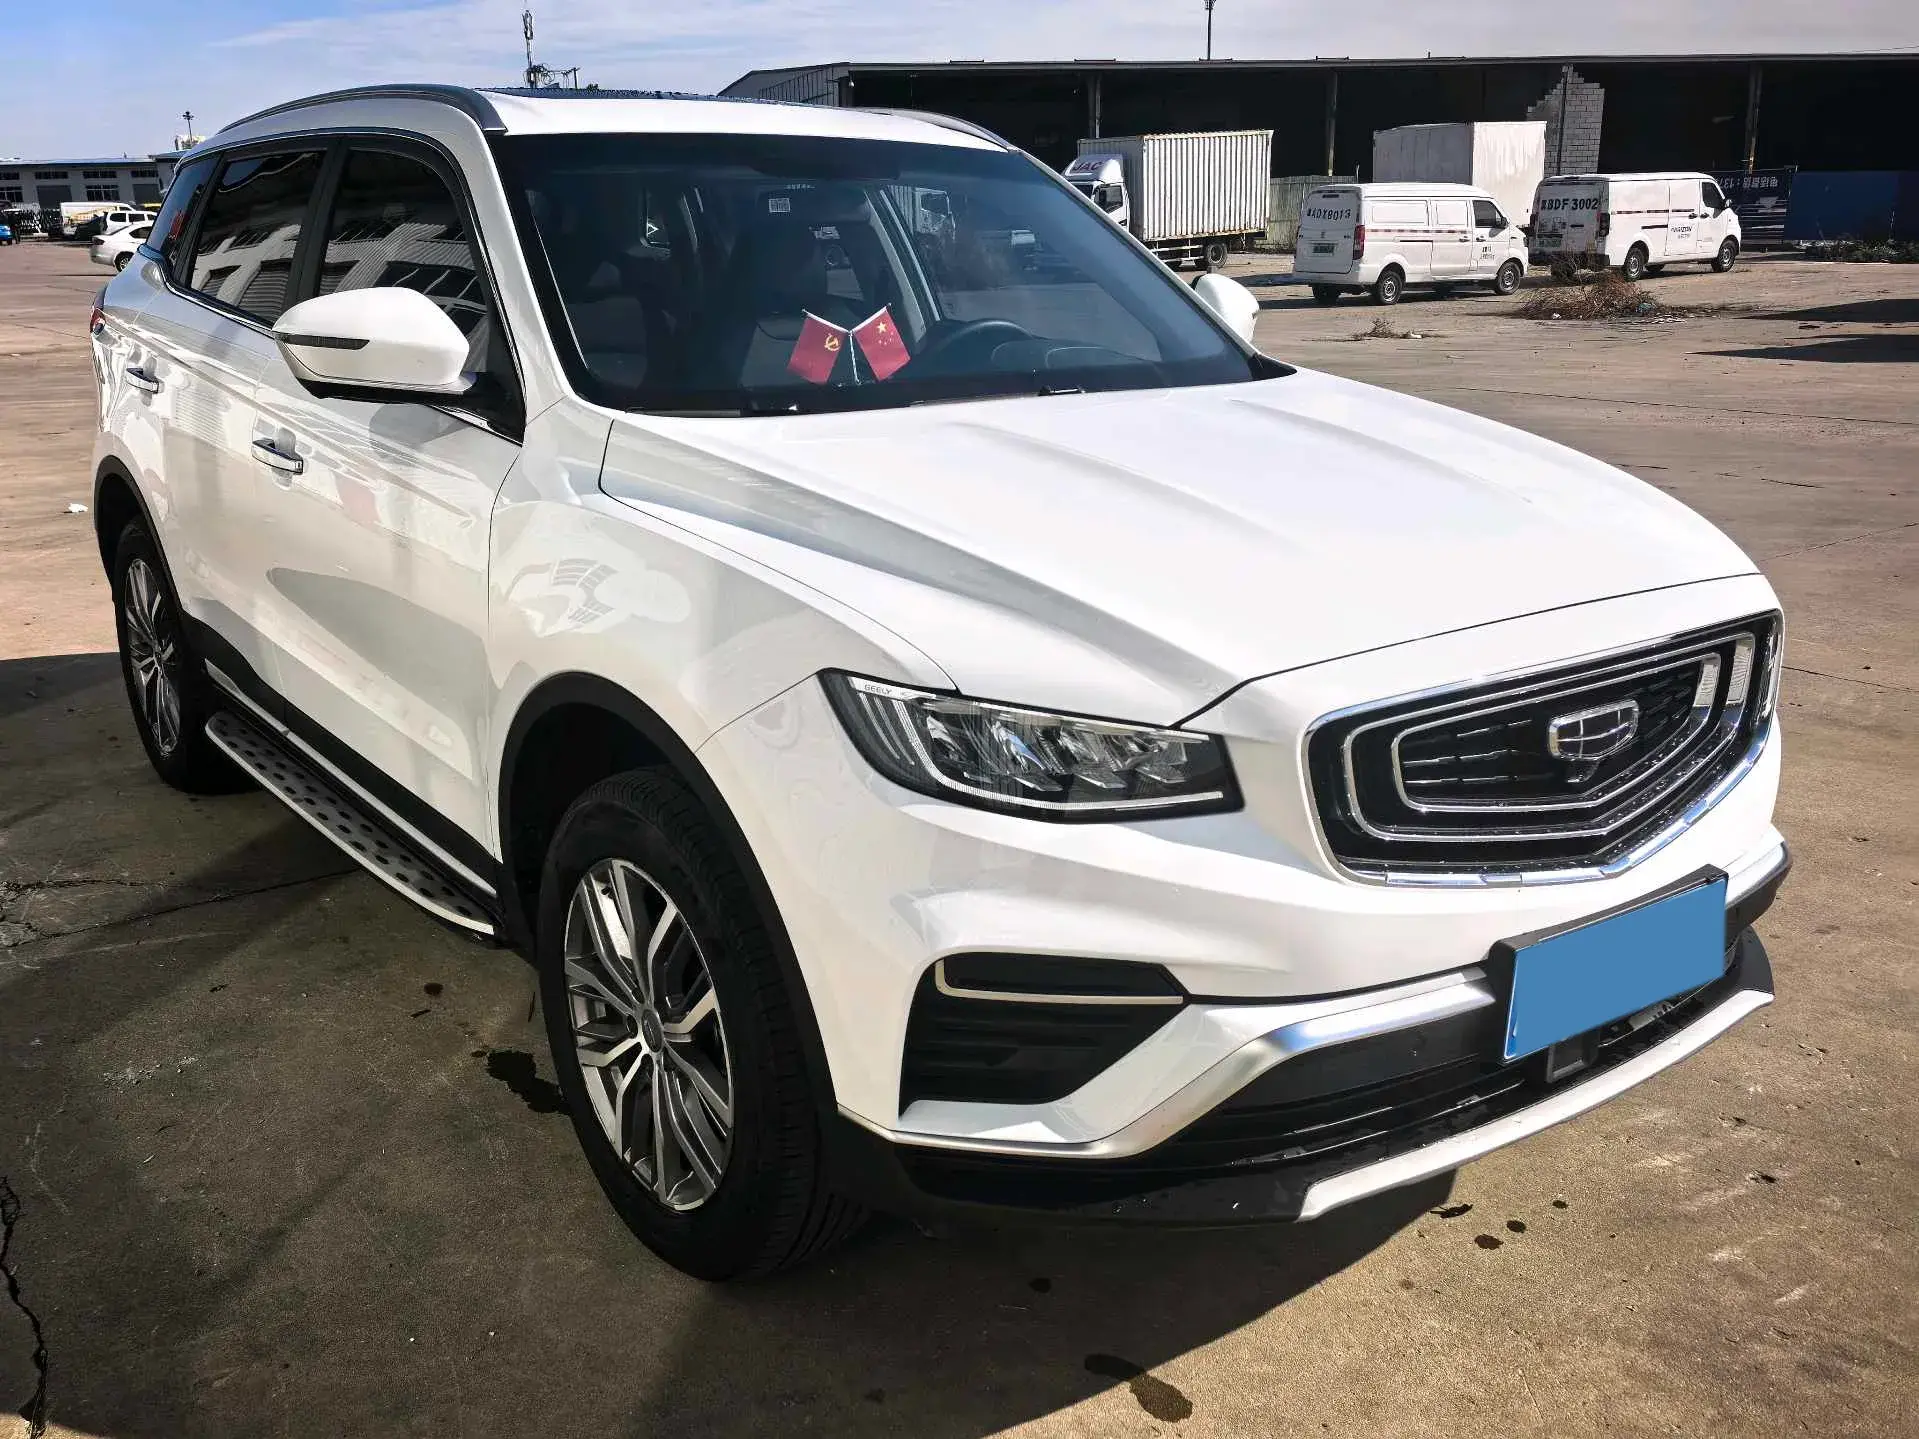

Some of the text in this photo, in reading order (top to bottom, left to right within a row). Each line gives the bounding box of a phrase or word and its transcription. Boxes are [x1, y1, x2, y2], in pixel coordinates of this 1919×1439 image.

[1073, 161, 1104, 171] JAC
[1571, 198, 1599, 210] 3002
[864, 684, 892, 695] GEELY
